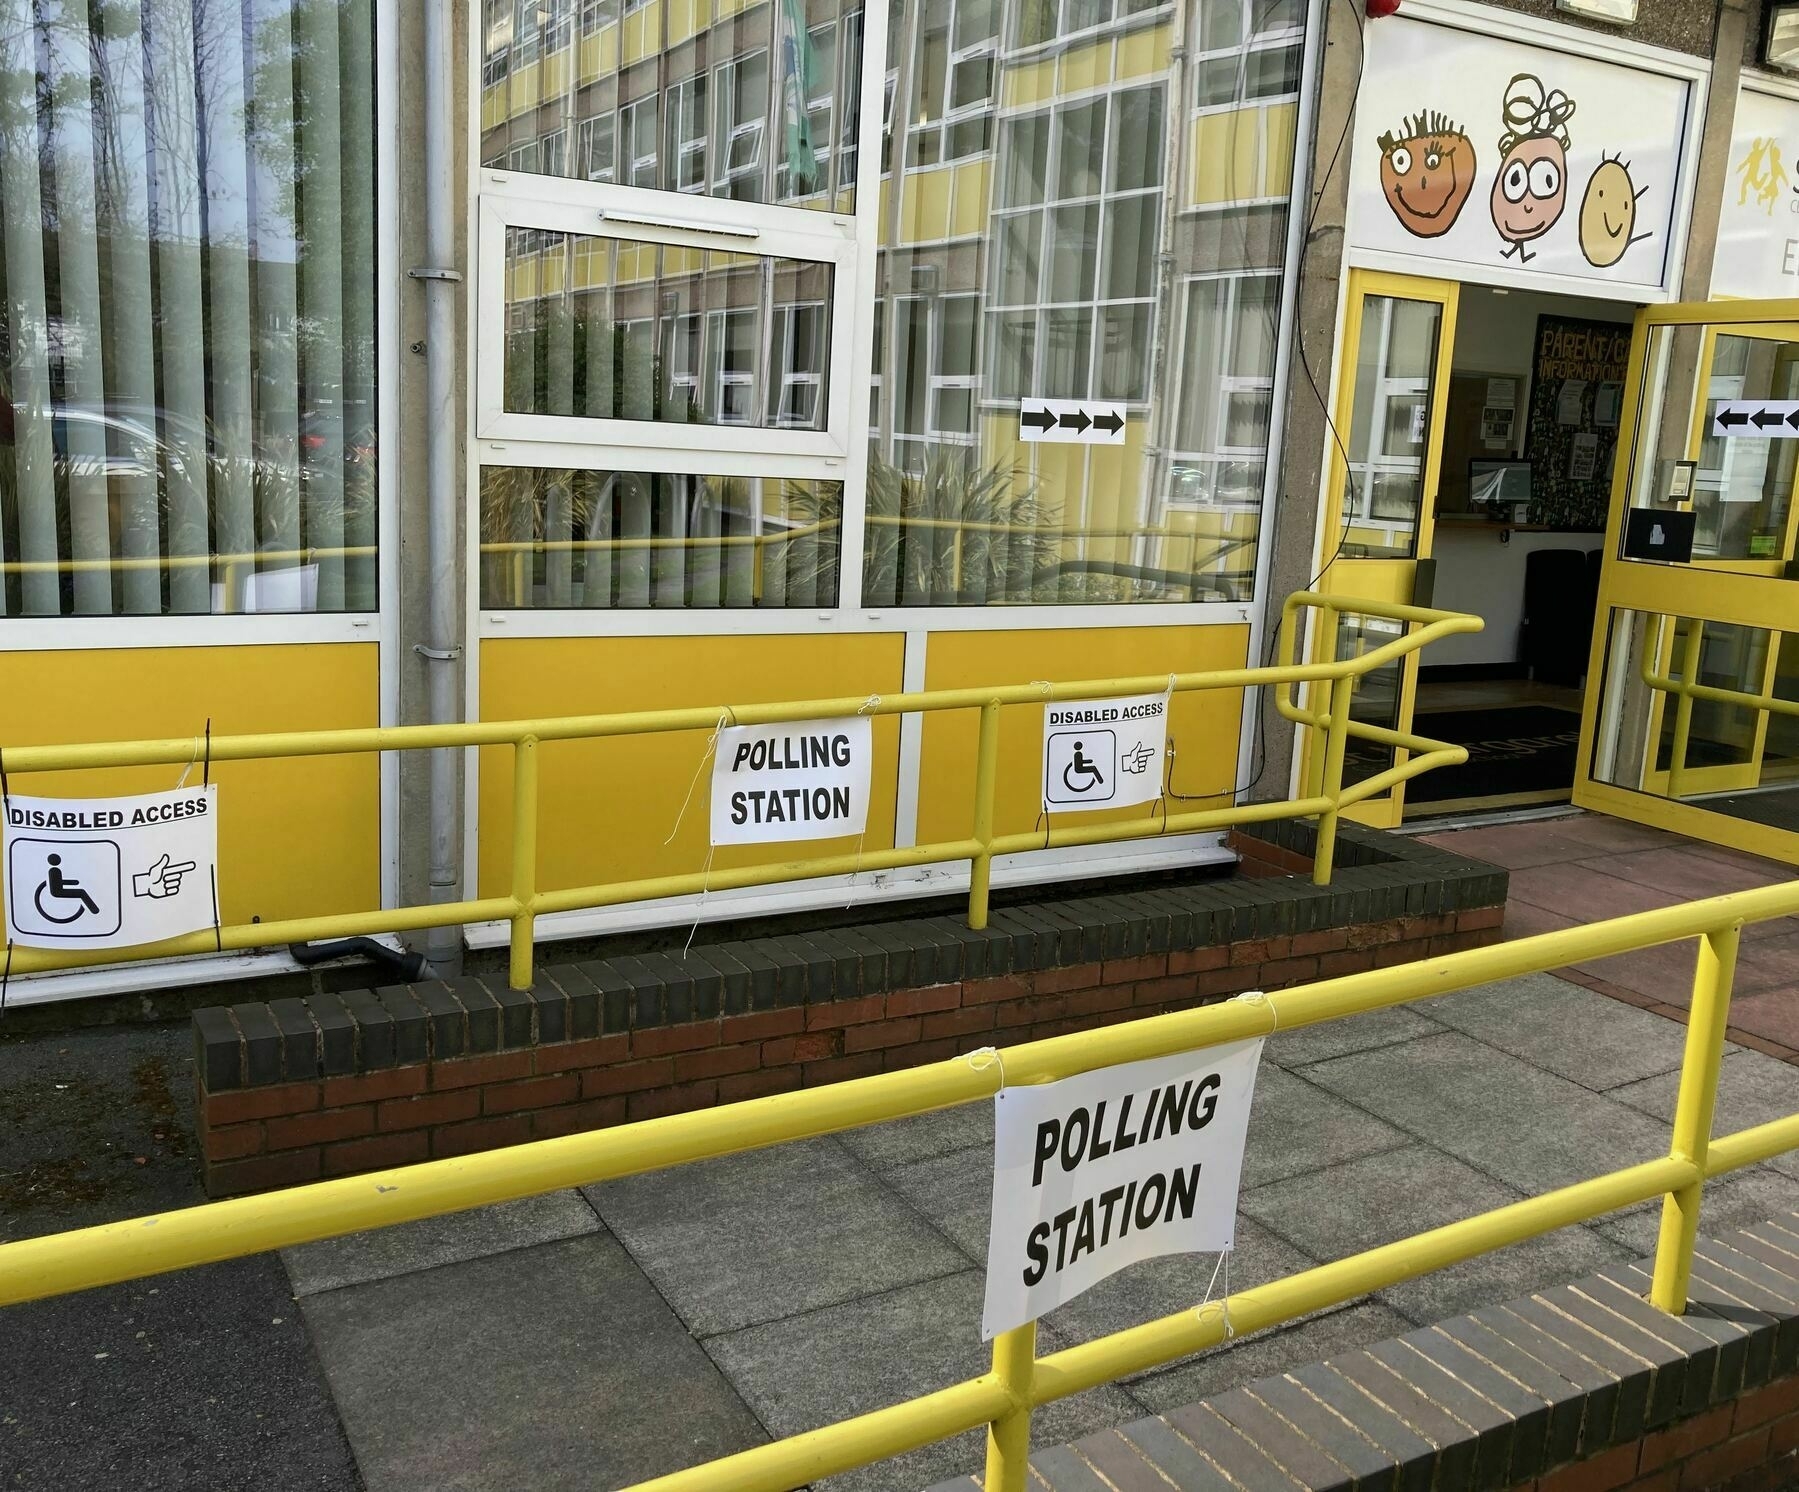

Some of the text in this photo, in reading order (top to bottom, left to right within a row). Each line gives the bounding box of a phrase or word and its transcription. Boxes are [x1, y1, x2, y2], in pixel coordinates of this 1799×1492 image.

[1050, 702, 1163, 724] DISABLED ACCESS
[732, 734, 850, 772] POLLING
[11, 797, 207, 828] DISABLED ACCESS
[731, 786, 850, 825] STATION
[1032, 1073, 1221, 1187] POLLING
[1023, 1163, 1202, 1287] STATION
